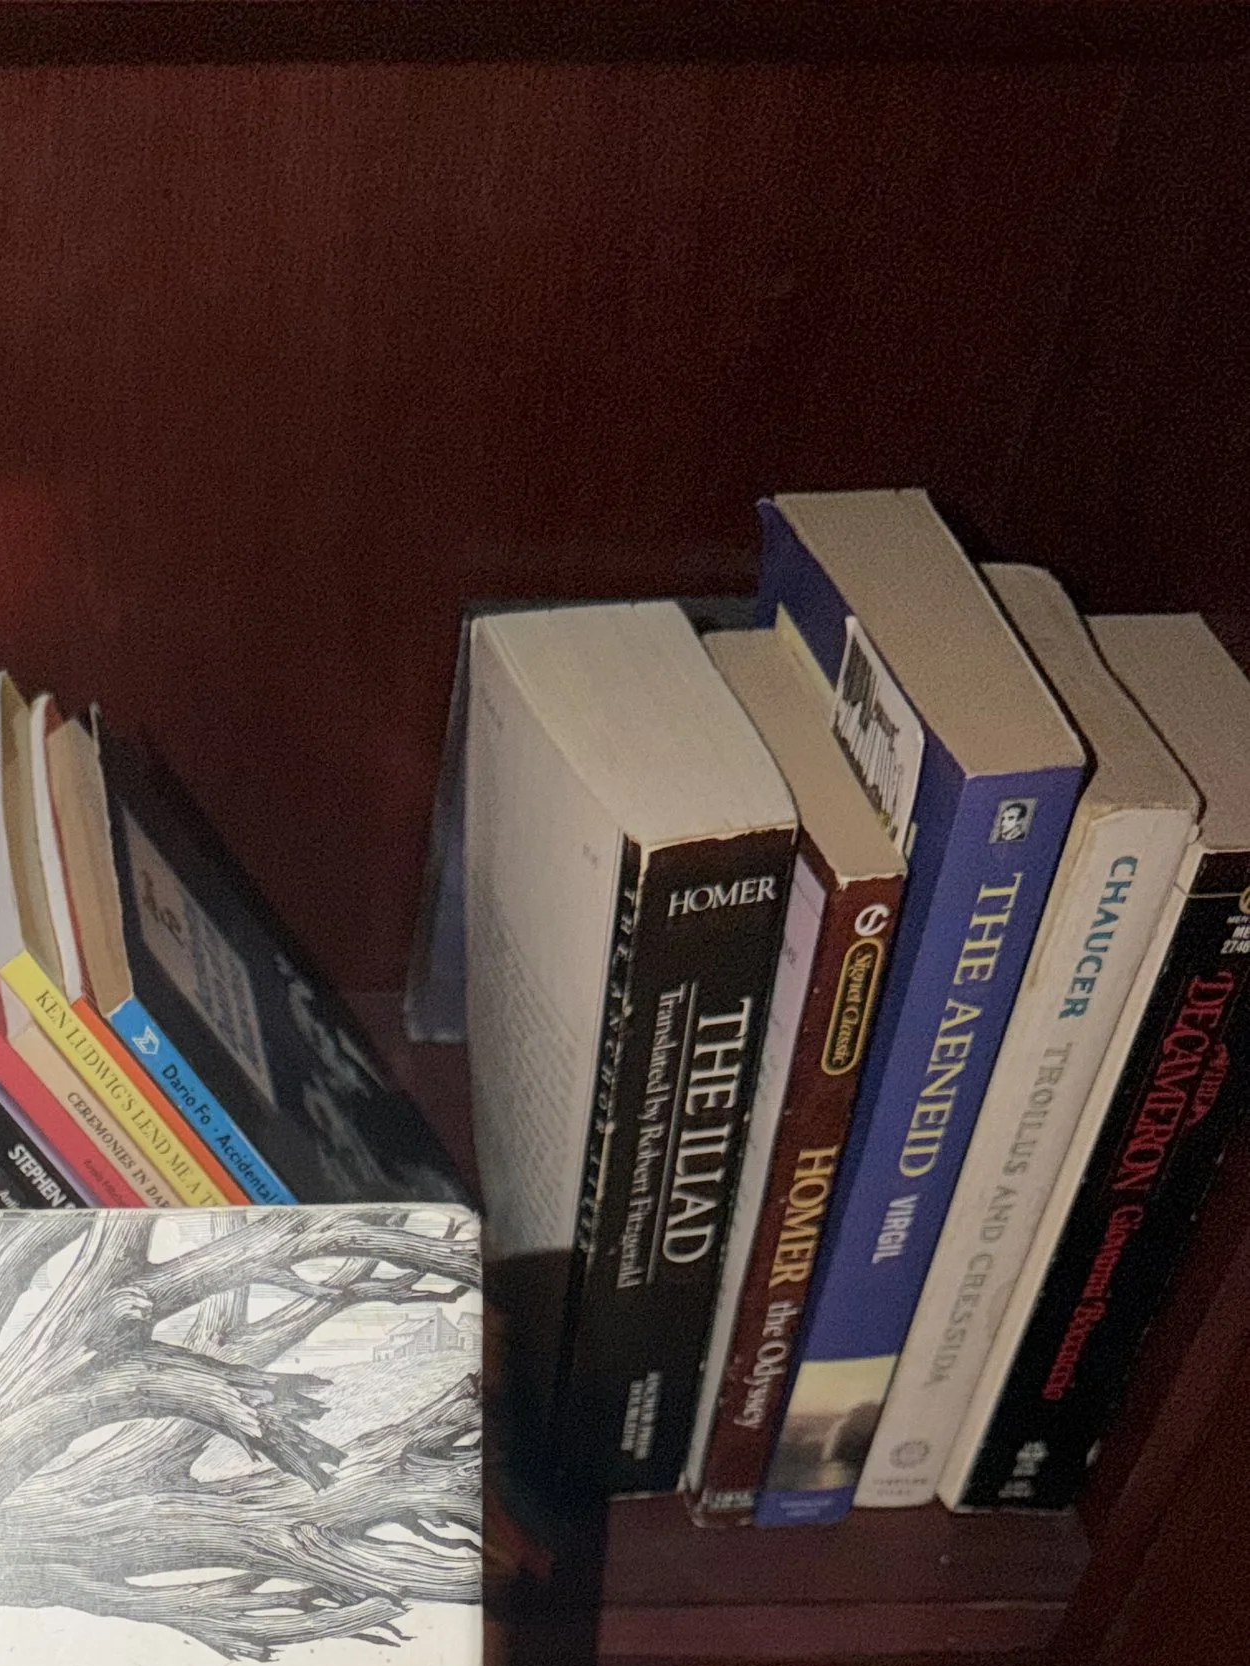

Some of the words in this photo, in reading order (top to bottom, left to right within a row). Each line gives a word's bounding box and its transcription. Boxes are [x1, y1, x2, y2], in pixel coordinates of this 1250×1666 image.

[667, 875, 777, 917] HOMER
[953, 872, 1023, 985] THE
[1058, 855, 1138, 1021] CHAUCER
[848, 949, 874, 1002] Signet
[35, 989, 71, 1031] KEN
[65, 1024, 139, 1111] LUDWIG'S
[131, 1102, 171, 1156] LEND
[166, 1152, 192, 1182] ME
[646, 983, 688, 1093] Translated
[685, 996, 751, 1117] THE
[898, 997, 983, 1178] AENEID
[1112, 967, 1234, 1192] DECAMERON
[66, 1091, 137, 1172] CEREMONIES
[131, 1167, 151, 1186] IN
[162, 1063, 197, 1108] Dario
[193, 1102, 211, 1126] Fo
[215, 1133, 279, 1206] Accidental
[631, 1122, 665, 1196] Robert
[638, 1089, 671, 1122] by
[1002, 1040, 1074, 1175] TROILUS
[7, 1143, 67, 1207] STEPHEN
[662, 1122, 733, 1264] ILIAD
[769, 1144, 840, 1288] HOMER
[872, 1193, 920, 1264] VIRGIL
[979, 1183, 1018, 1245] AND
[762, 1301, 800, 1340] the
[923, 1252, 995, 1388] CRESSIDA
[733, 1340, 788, 1429] Odyssey
